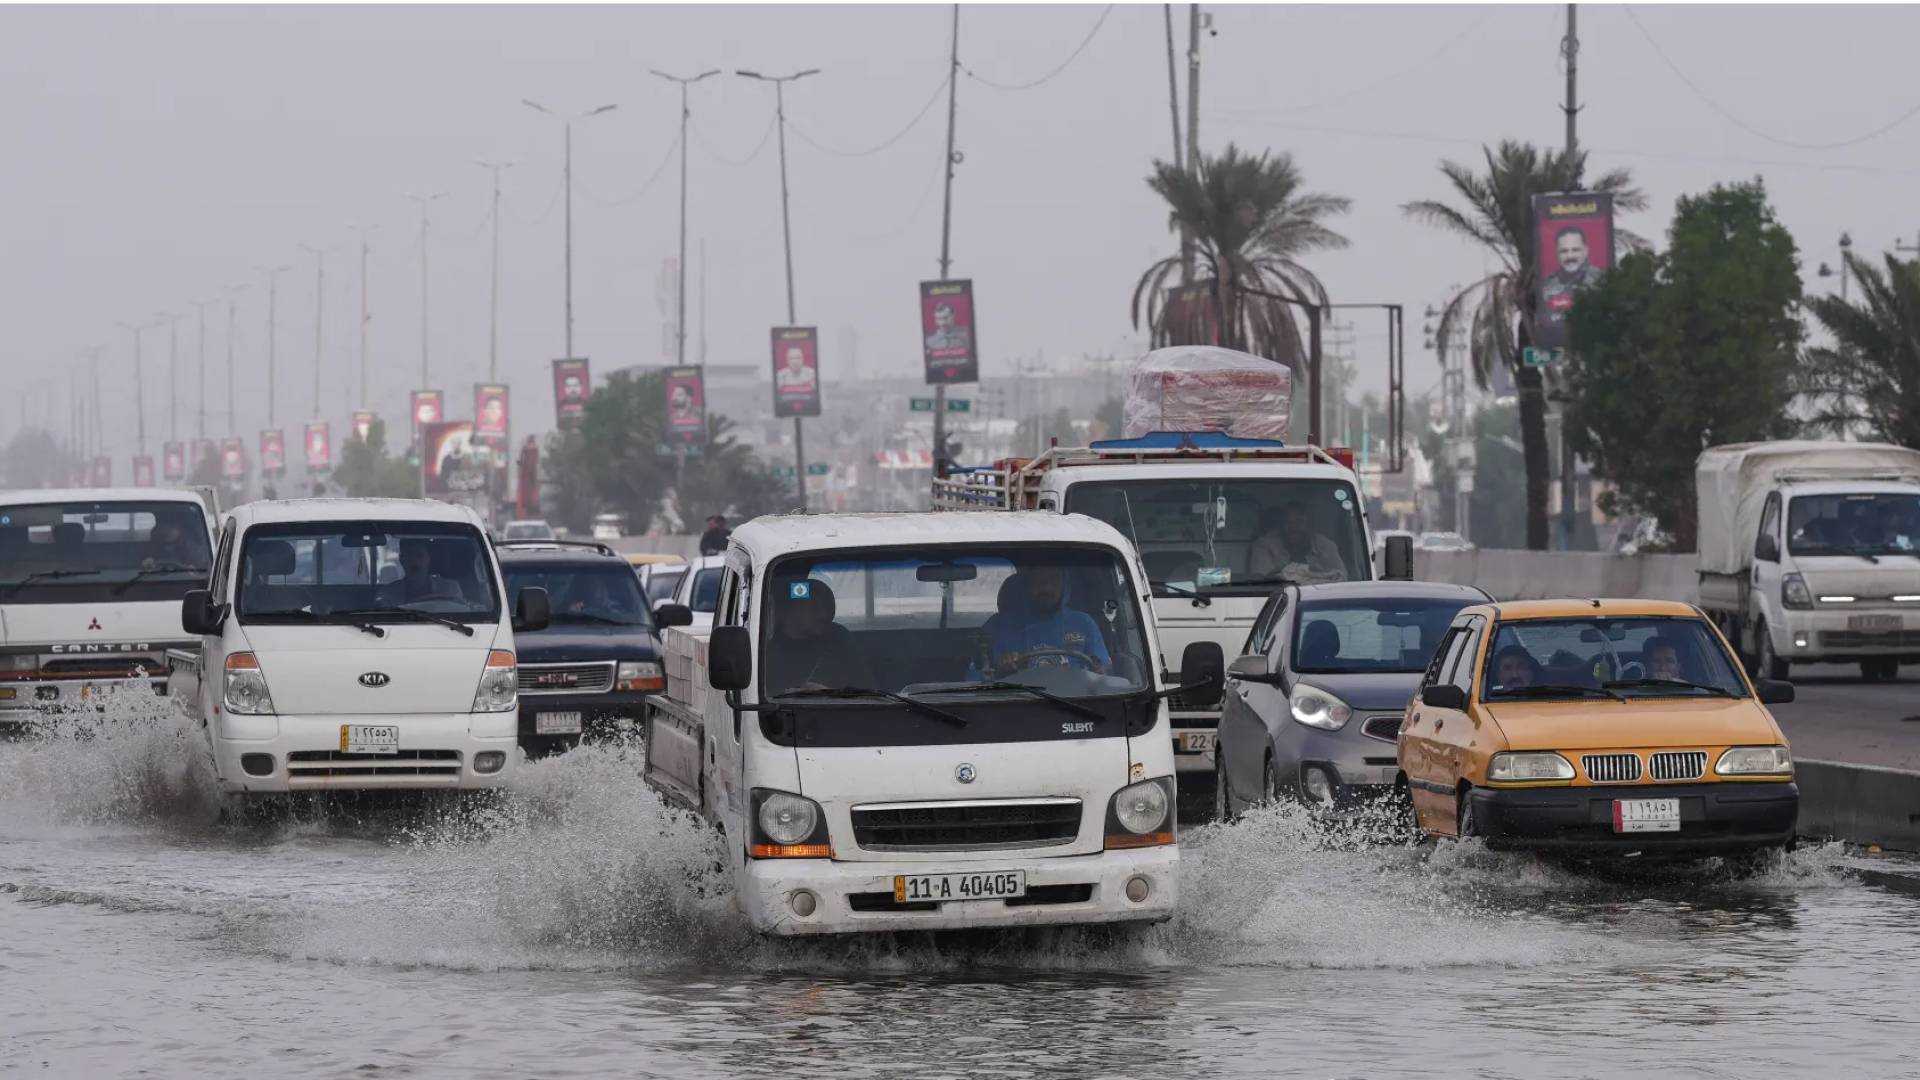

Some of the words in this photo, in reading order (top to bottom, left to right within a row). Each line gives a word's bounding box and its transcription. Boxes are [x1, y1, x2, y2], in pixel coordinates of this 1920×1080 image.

[51, 643, 149, 653] CANTER
[363, 673, 385, 684] KIA
[960, 874, 1018, 896] 40405
